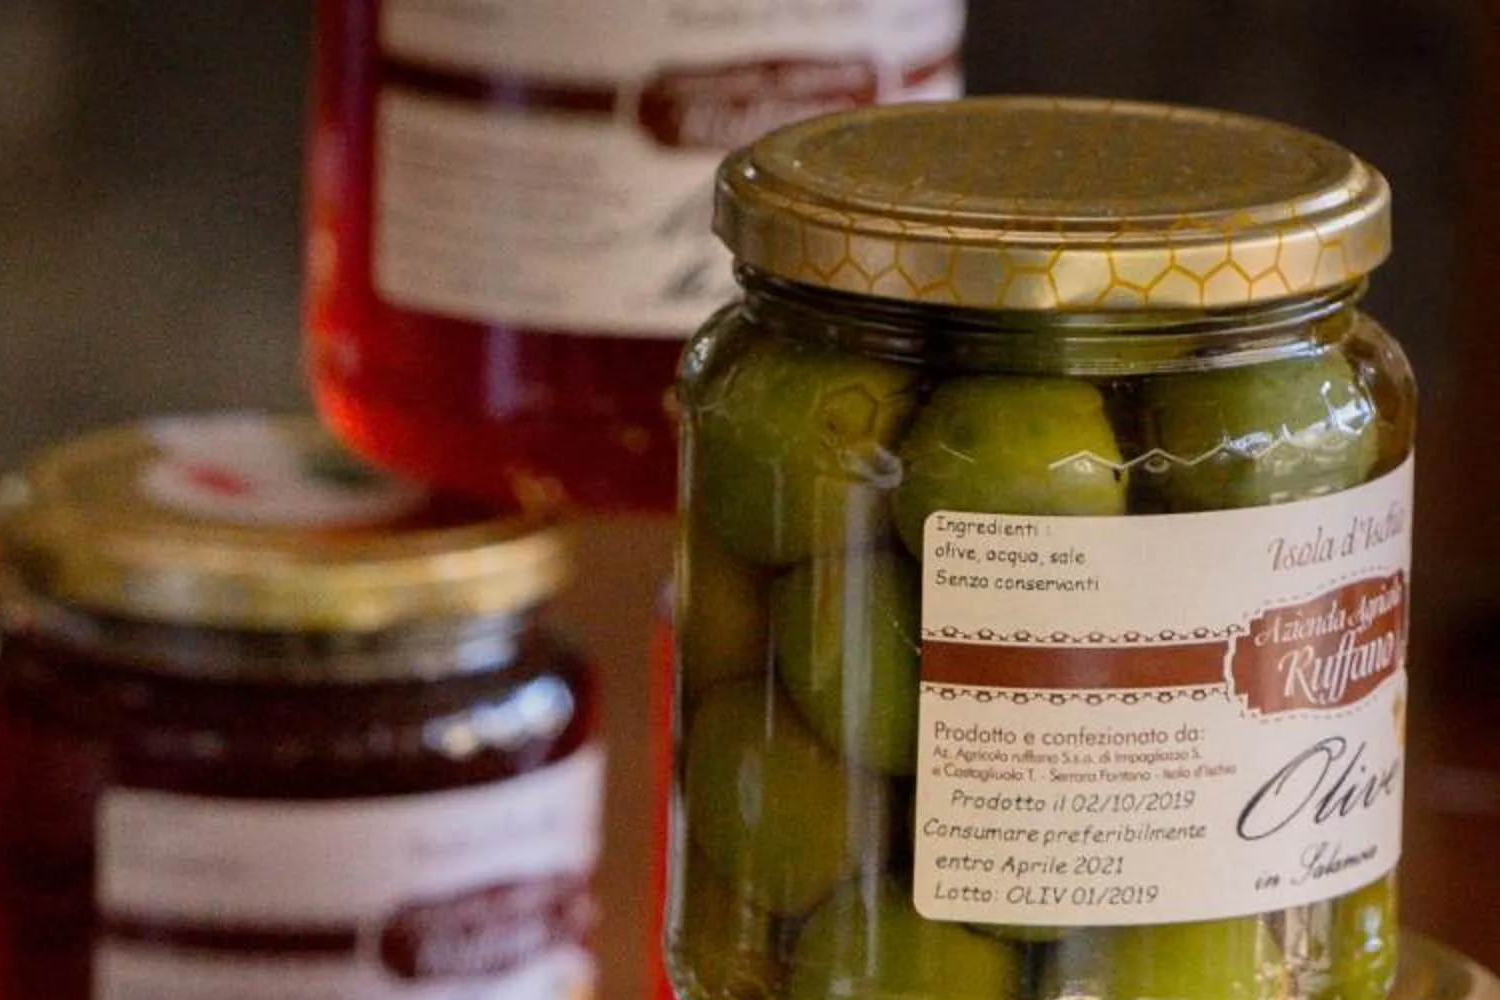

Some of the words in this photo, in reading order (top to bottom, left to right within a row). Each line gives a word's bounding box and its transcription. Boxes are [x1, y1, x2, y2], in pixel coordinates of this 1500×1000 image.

[1050, 547, 1086, 564] sale
[1268, 526, 1334, 571] Isola
[935, 570, 988, 587] Senza
[995, 576, 1099, 591] conservanti
[1254, 600, 1347, 647] Azienda
[1278, 629, 1394, 705] Ruffano
[934, 720, 1017, 745] Prodotto
[1024, 732, 1035, 745] e
[1042, 726, 1168, 747] confezionato
[951, 789, 1046, 813] Prodotto
[1072, 790, 1196, 814] 02/10/2019
[923, 818, 1042, 841] Consumare
[1043, 820, 1207, 845] preferibilmente
[935, 854, 995, 872] entro
[1000, 855, 1069, 878] Aprile
[1074, 855, 1124, 876] 2021
[1007, 887, 1068, 906] OLIV
[1072, 884, 1159, 906] 01/2019
